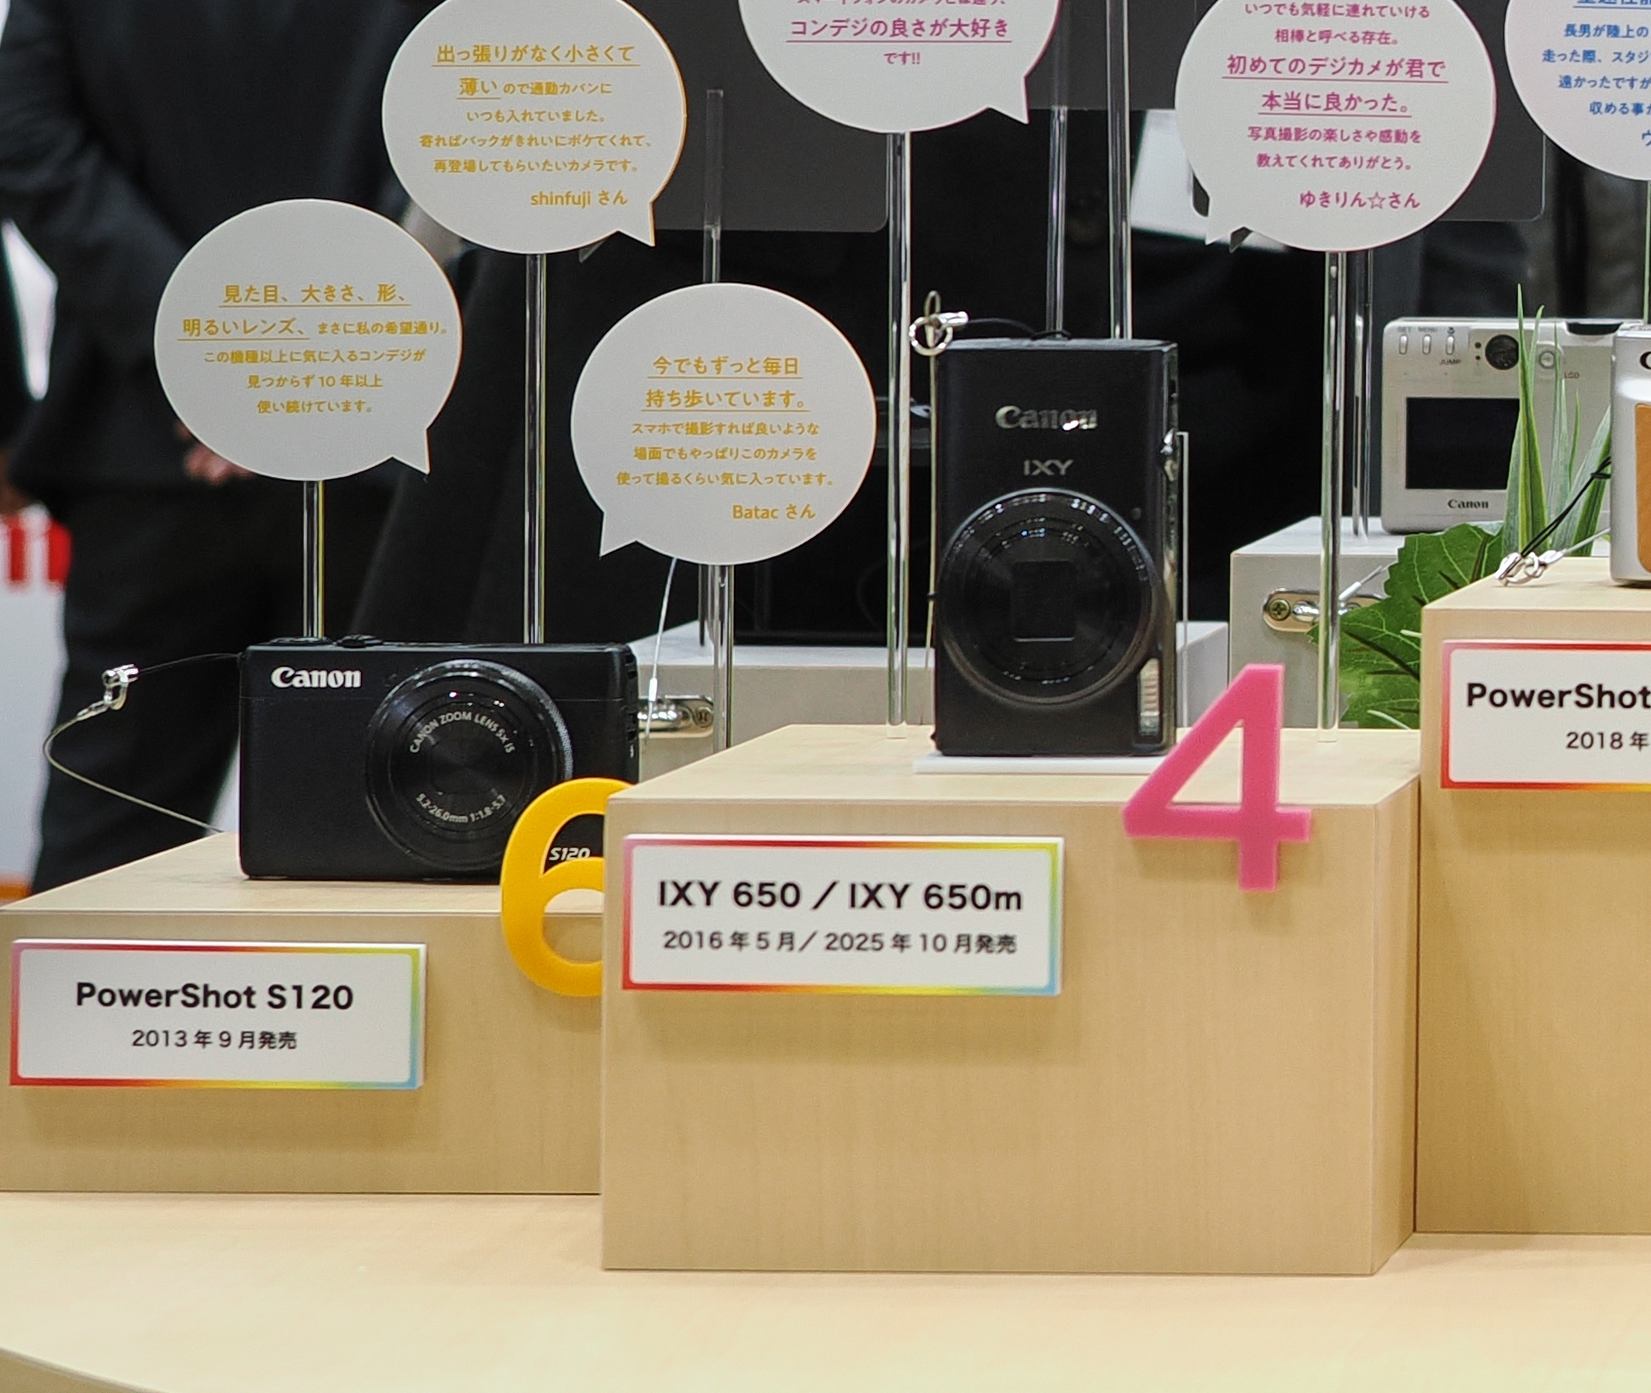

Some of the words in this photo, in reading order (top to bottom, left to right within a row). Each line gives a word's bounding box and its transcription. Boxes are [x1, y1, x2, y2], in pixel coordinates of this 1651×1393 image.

[1275, 29, 1397, 44] 相棒と呼べる存在。
[460, 78, 497, 96] 薄い
[503, 82, 611, 95] ので通勤カバンに
[1262, 91, 1407, 112] 本当に良かった。
[531, 191, 590, 208] shinfuji
[598, 190, 627, 205] さん
[223, 284, 404, 303] 見た目、大きさ、形、
[183, 318, 303, 337] 明るいレンズ、
[318, 321, 446, 335] まさに私の希望通り。
[653, 356, 798, 375] 今でもずっと毎日
[248, 375, 315, 388] 見つからず
[319, 376, 336, 387] 10
[340, 374, 382, 387] 年以上
[257, 400, 371, 413] 使い続けています。
[646, 389, 803, 408] 持ち歩いています。
[996, 405, 1098, 430] Canon
[1024, 459, 1074, 476] IXY
[733, 505, 778, 519] Batac
[786, 504, 815, 519] さん
[1448, 499, 1488, 509] Canon
[271, 666, 361, 689] Canon
[1468, 683, 1651, 709] PowerShot
[1121, 664, 1311, 890] 4
[501, 778, 635, 996] 6
[660, 881, 719, 906] IXY
[734, 882, 800, 907] 650
[851, 883, 910, 908] IXY
[924, 884, 1021, 910] 650m
[77, 982, 255, 1008] PowerShot
[268, 985, 353, 1009] S120
